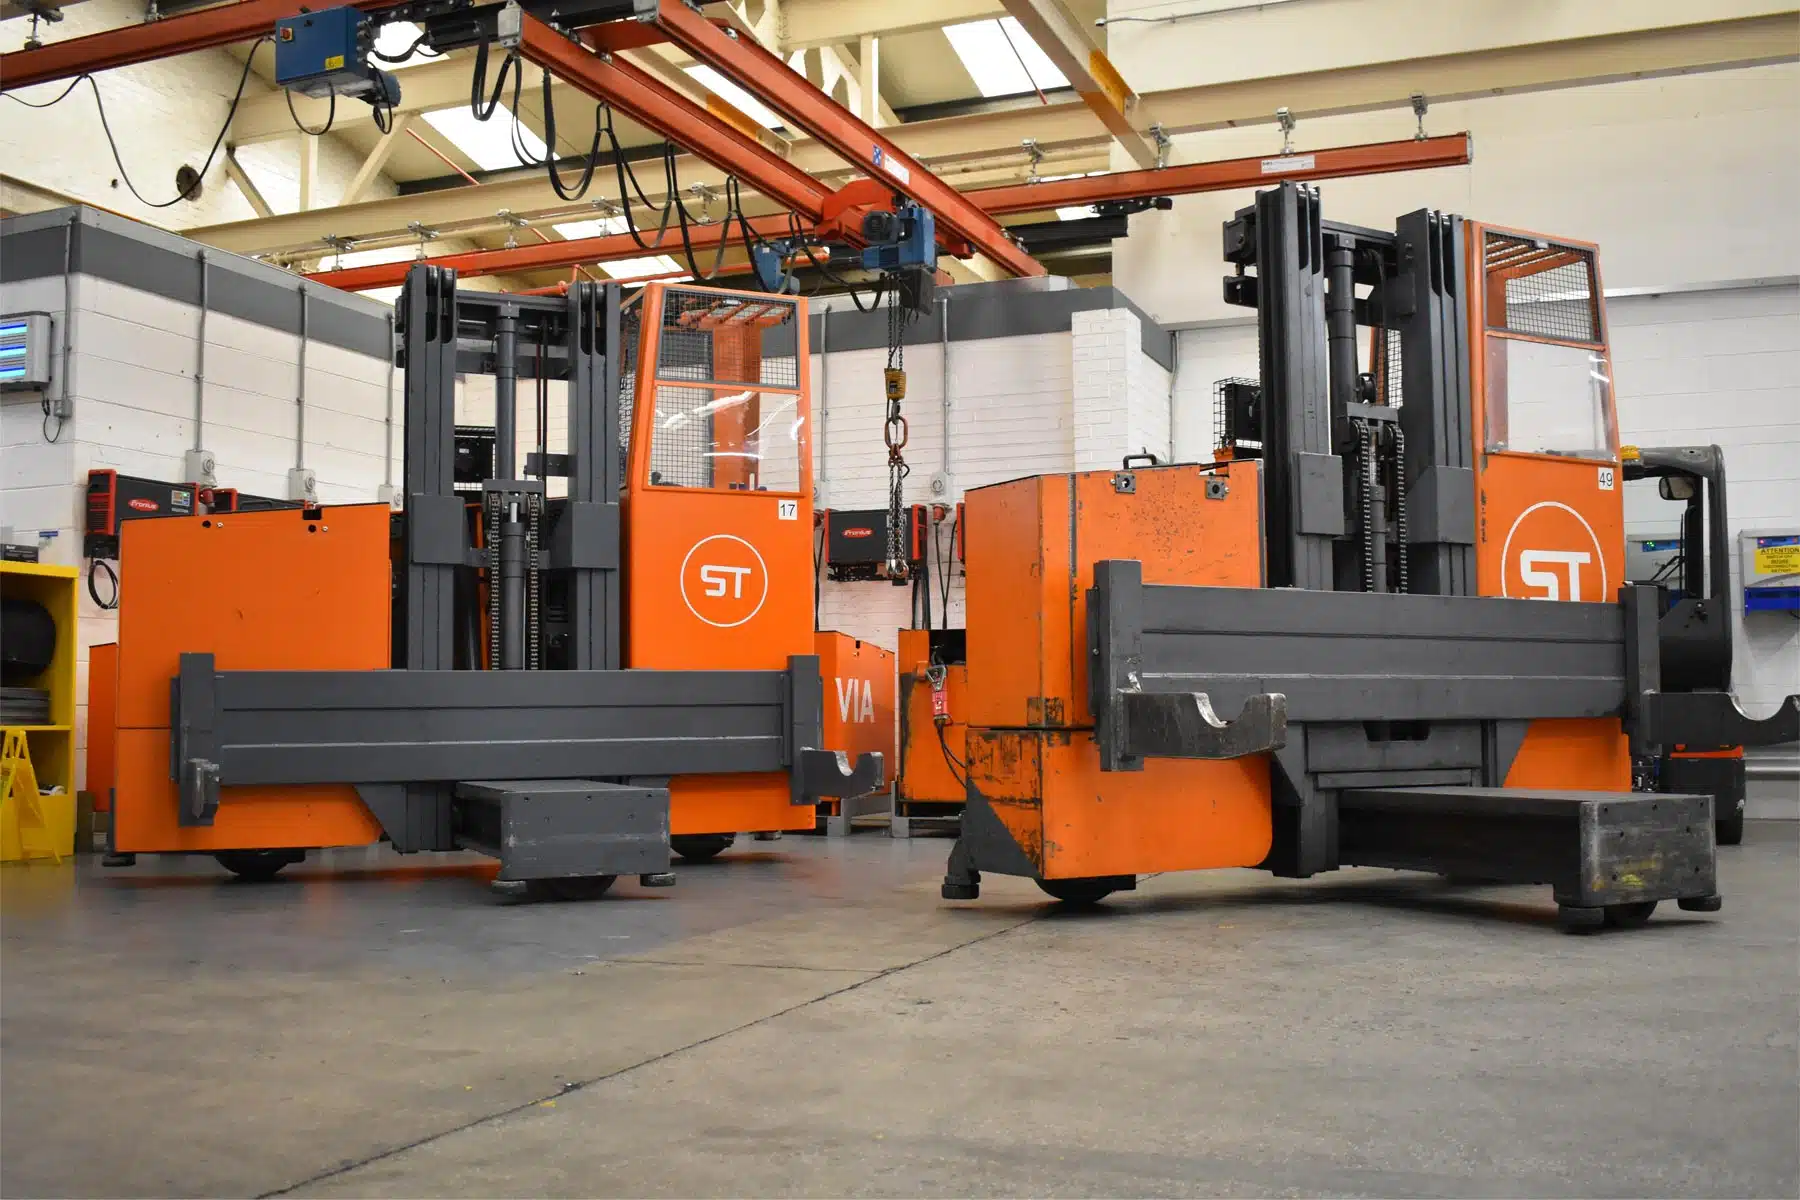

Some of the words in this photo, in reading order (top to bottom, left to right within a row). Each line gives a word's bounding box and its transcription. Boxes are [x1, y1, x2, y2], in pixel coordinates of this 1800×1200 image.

[1599, 471, 1613, 487] 49
[780, 503, 796, 517] 17
[700, 564, 752, 598] ST
[1519, 549, 1591, 602] ST
[834, 677, 875, 723] VIA
